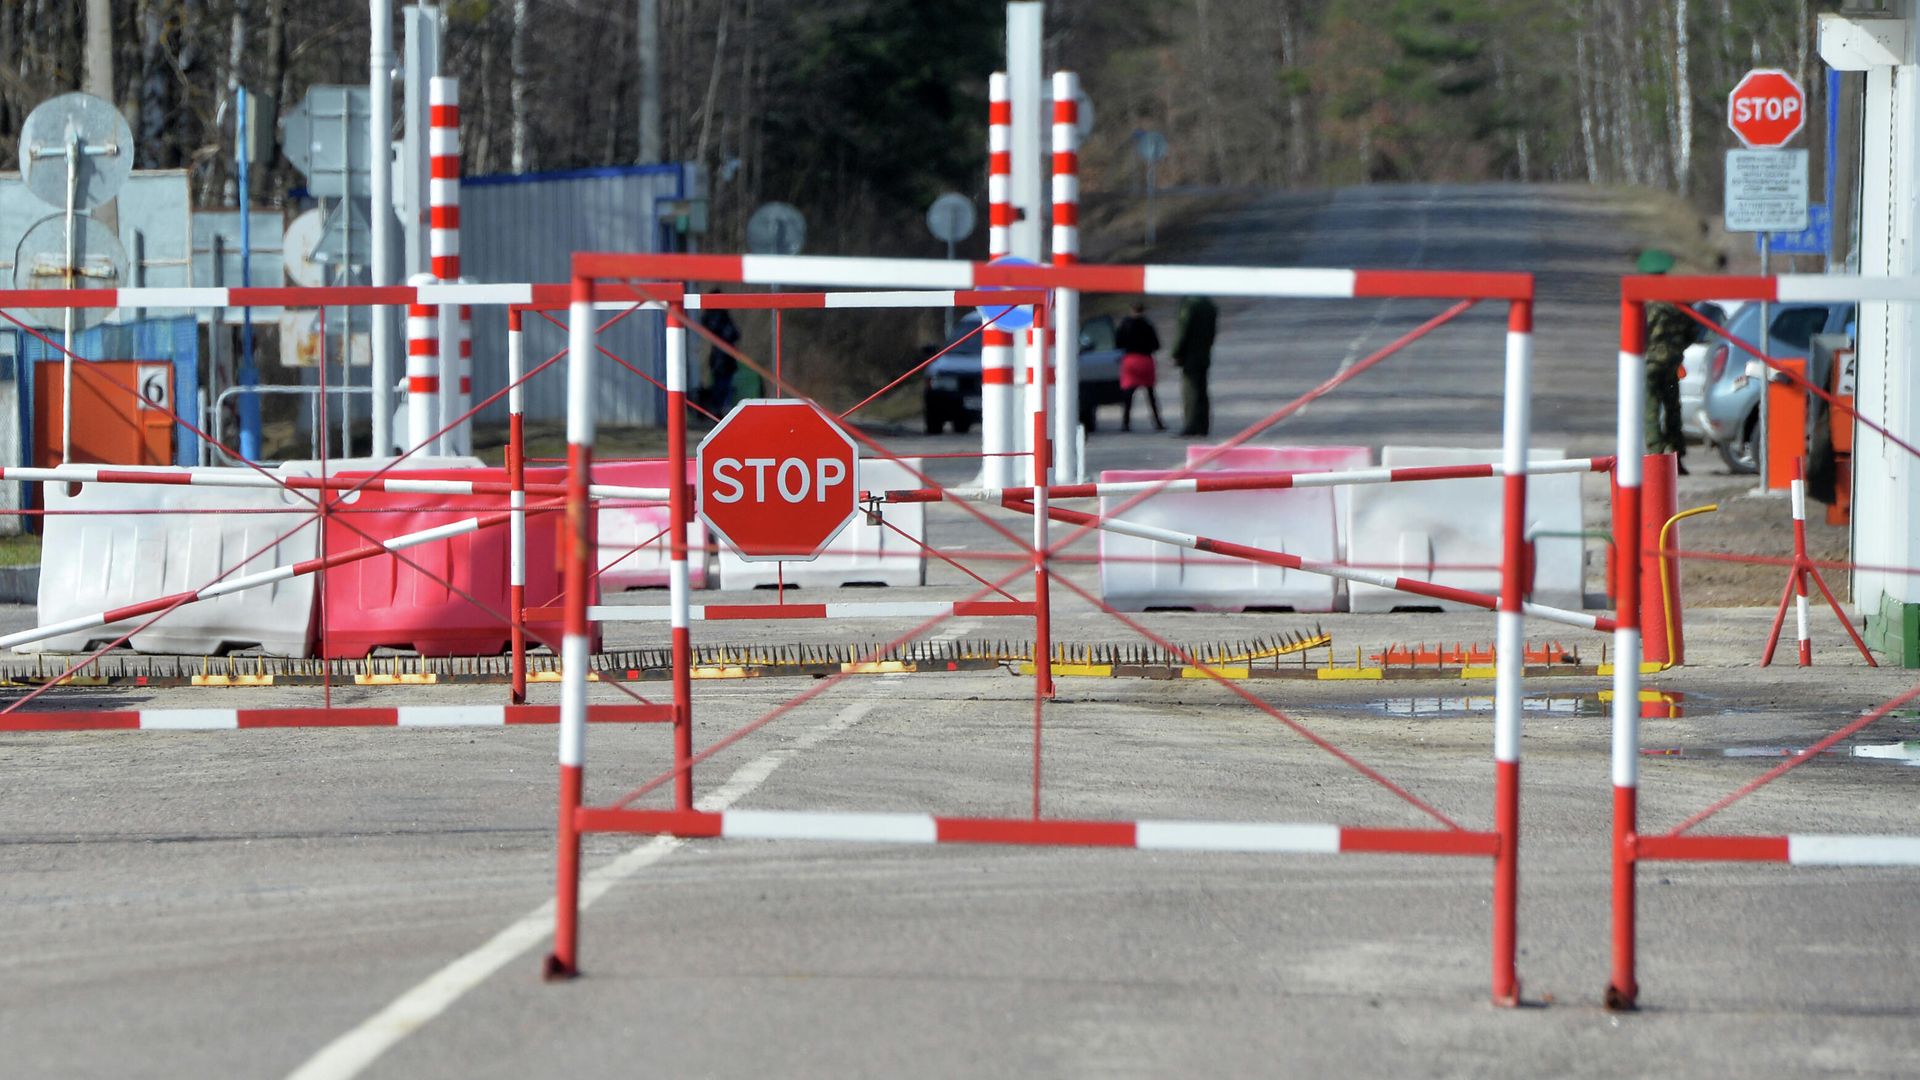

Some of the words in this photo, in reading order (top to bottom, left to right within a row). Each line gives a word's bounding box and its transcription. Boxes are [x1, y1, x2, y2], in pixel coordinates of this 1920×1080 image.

[1736, 96, 1798, 122] STOP
[143, 371, 164, 407] 6
[712, 457, 846, 503] STOP
